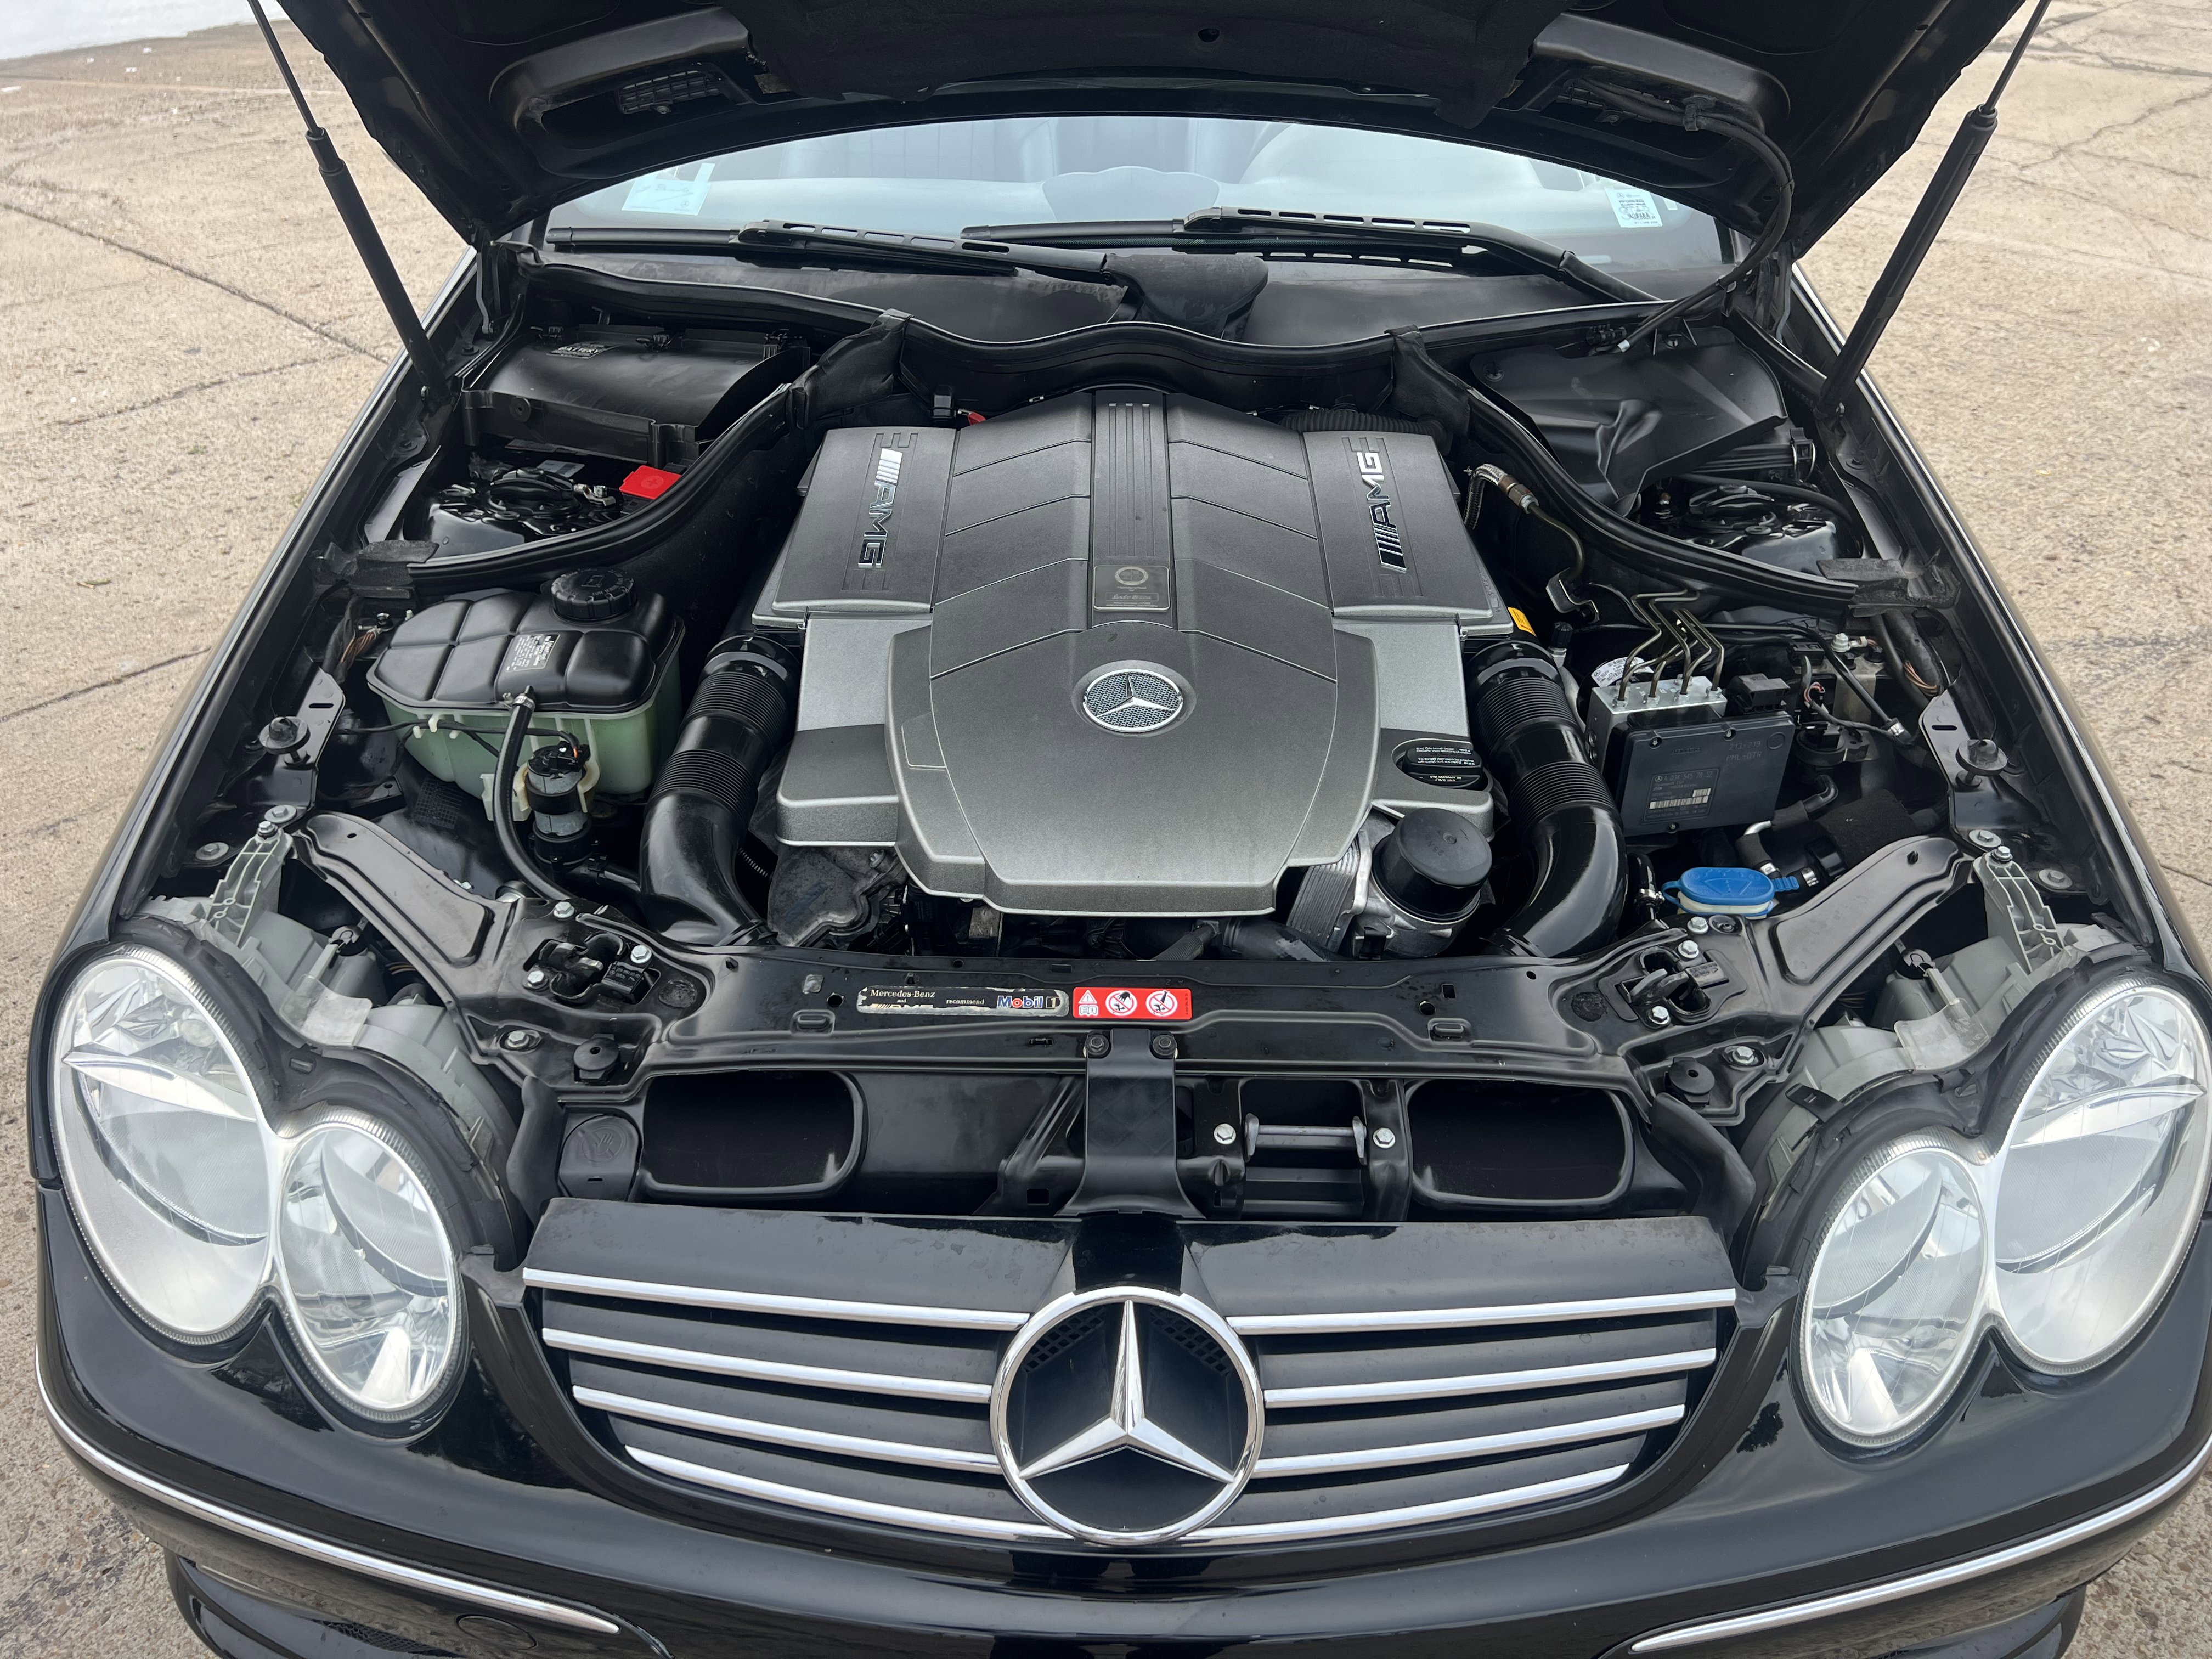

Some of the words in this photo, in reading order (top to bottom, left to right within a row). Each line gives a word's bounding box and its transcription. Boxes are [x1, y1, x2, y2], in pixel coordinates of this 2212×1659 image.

[1357, 452, 1397, 531] AMG
[858, 480, 897, 568] AMG
[870, 989, 935, 998] Mercedes-Benz
[996, 995, 1043, 1009] Mobil
